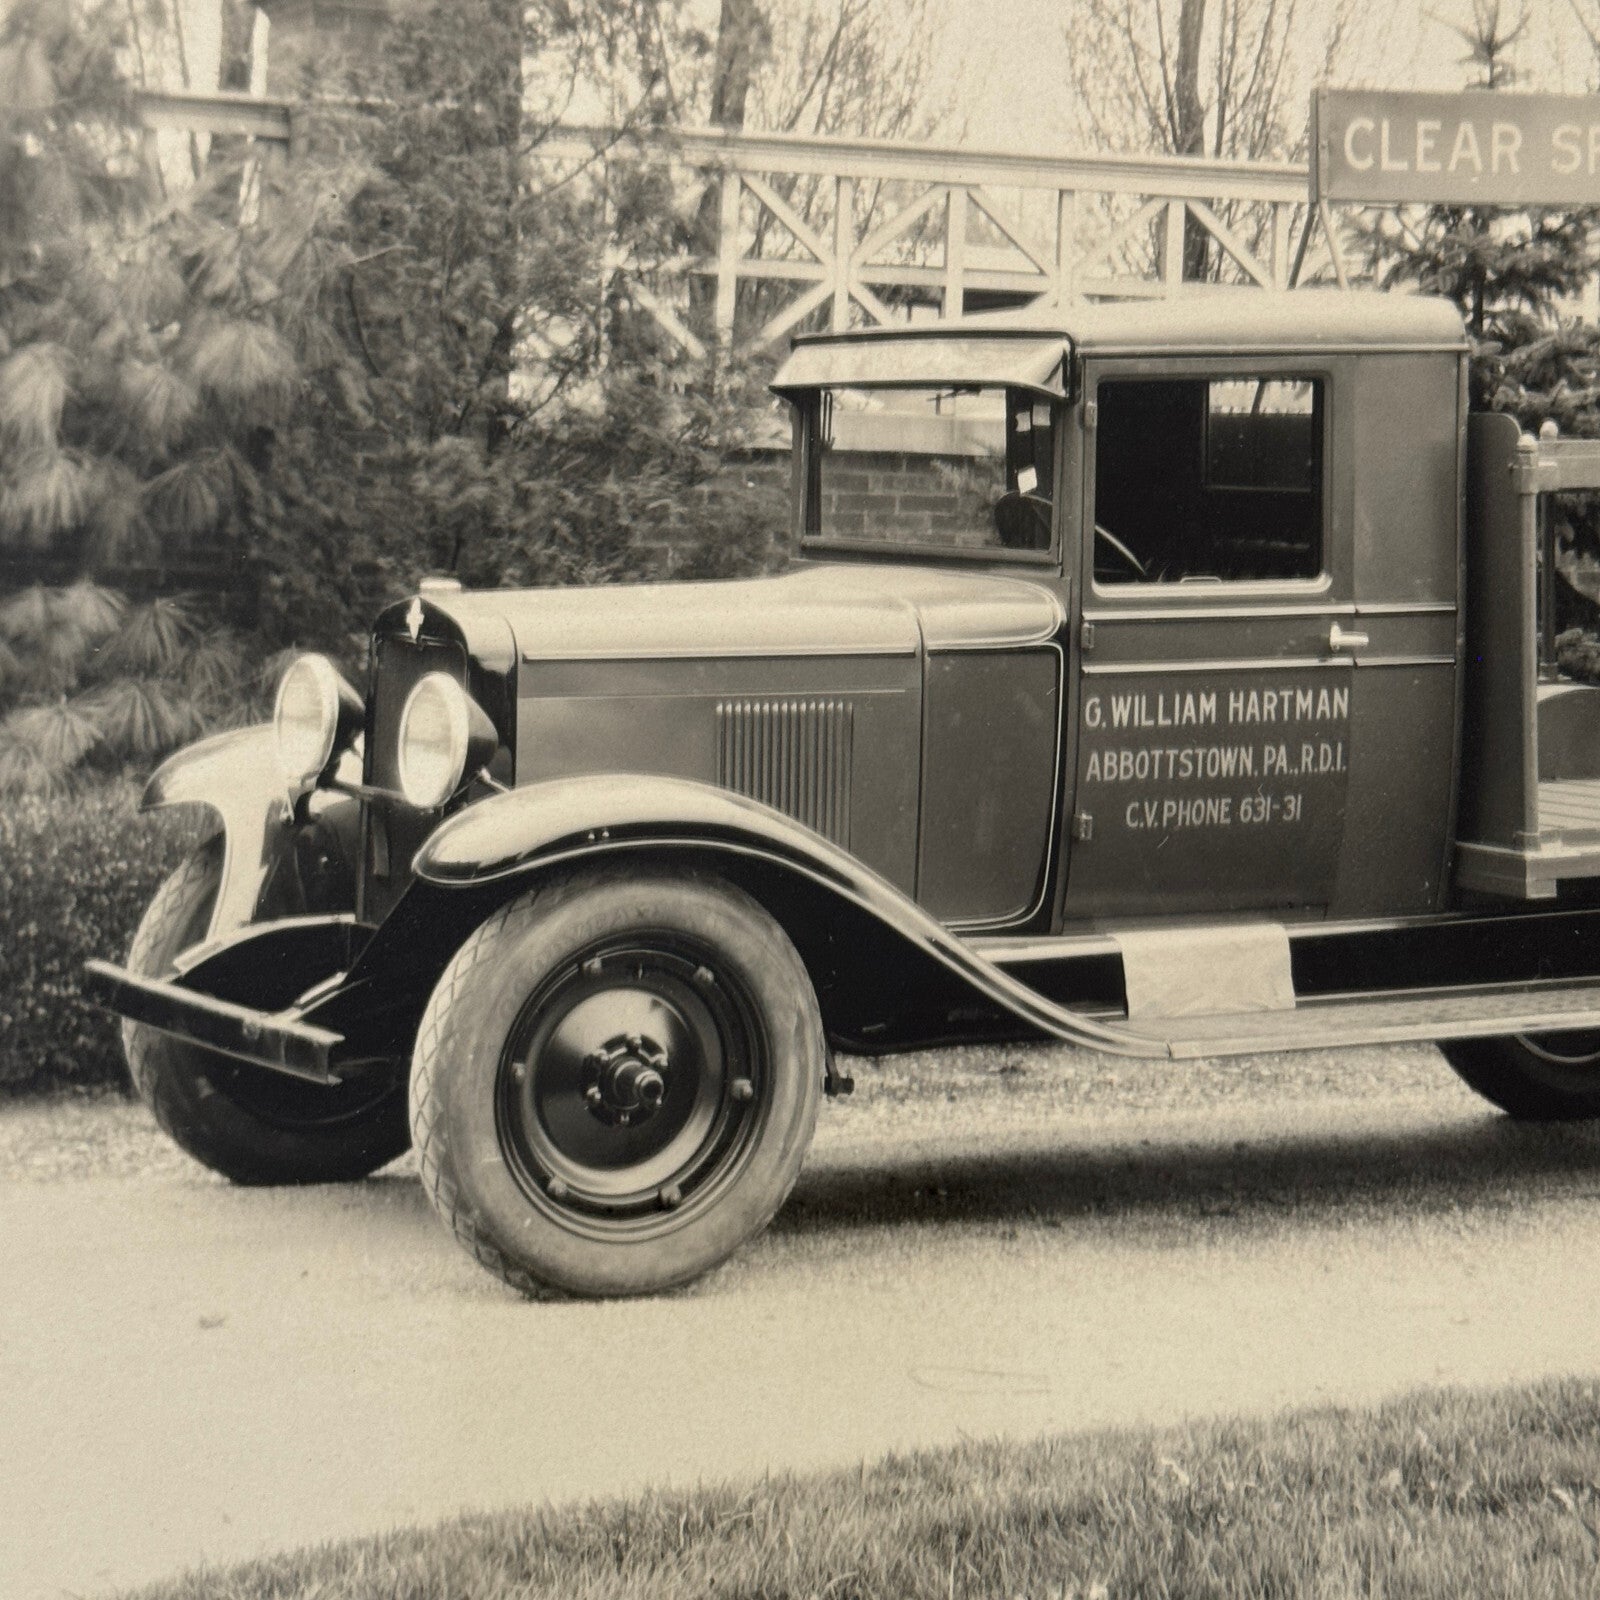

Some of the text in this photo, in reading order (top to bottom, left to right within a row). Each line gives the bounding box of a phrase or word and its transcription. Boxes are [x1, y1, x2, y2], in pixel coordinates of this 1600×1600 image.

[1343, 117, 1523, 174] CLEAR
[1084, 687, 1349, 728] G. WILLIAM HARTMAN
[1163, 797, 1232, 828] PHONE
[1239, 794, 1302, 824] 631-31
